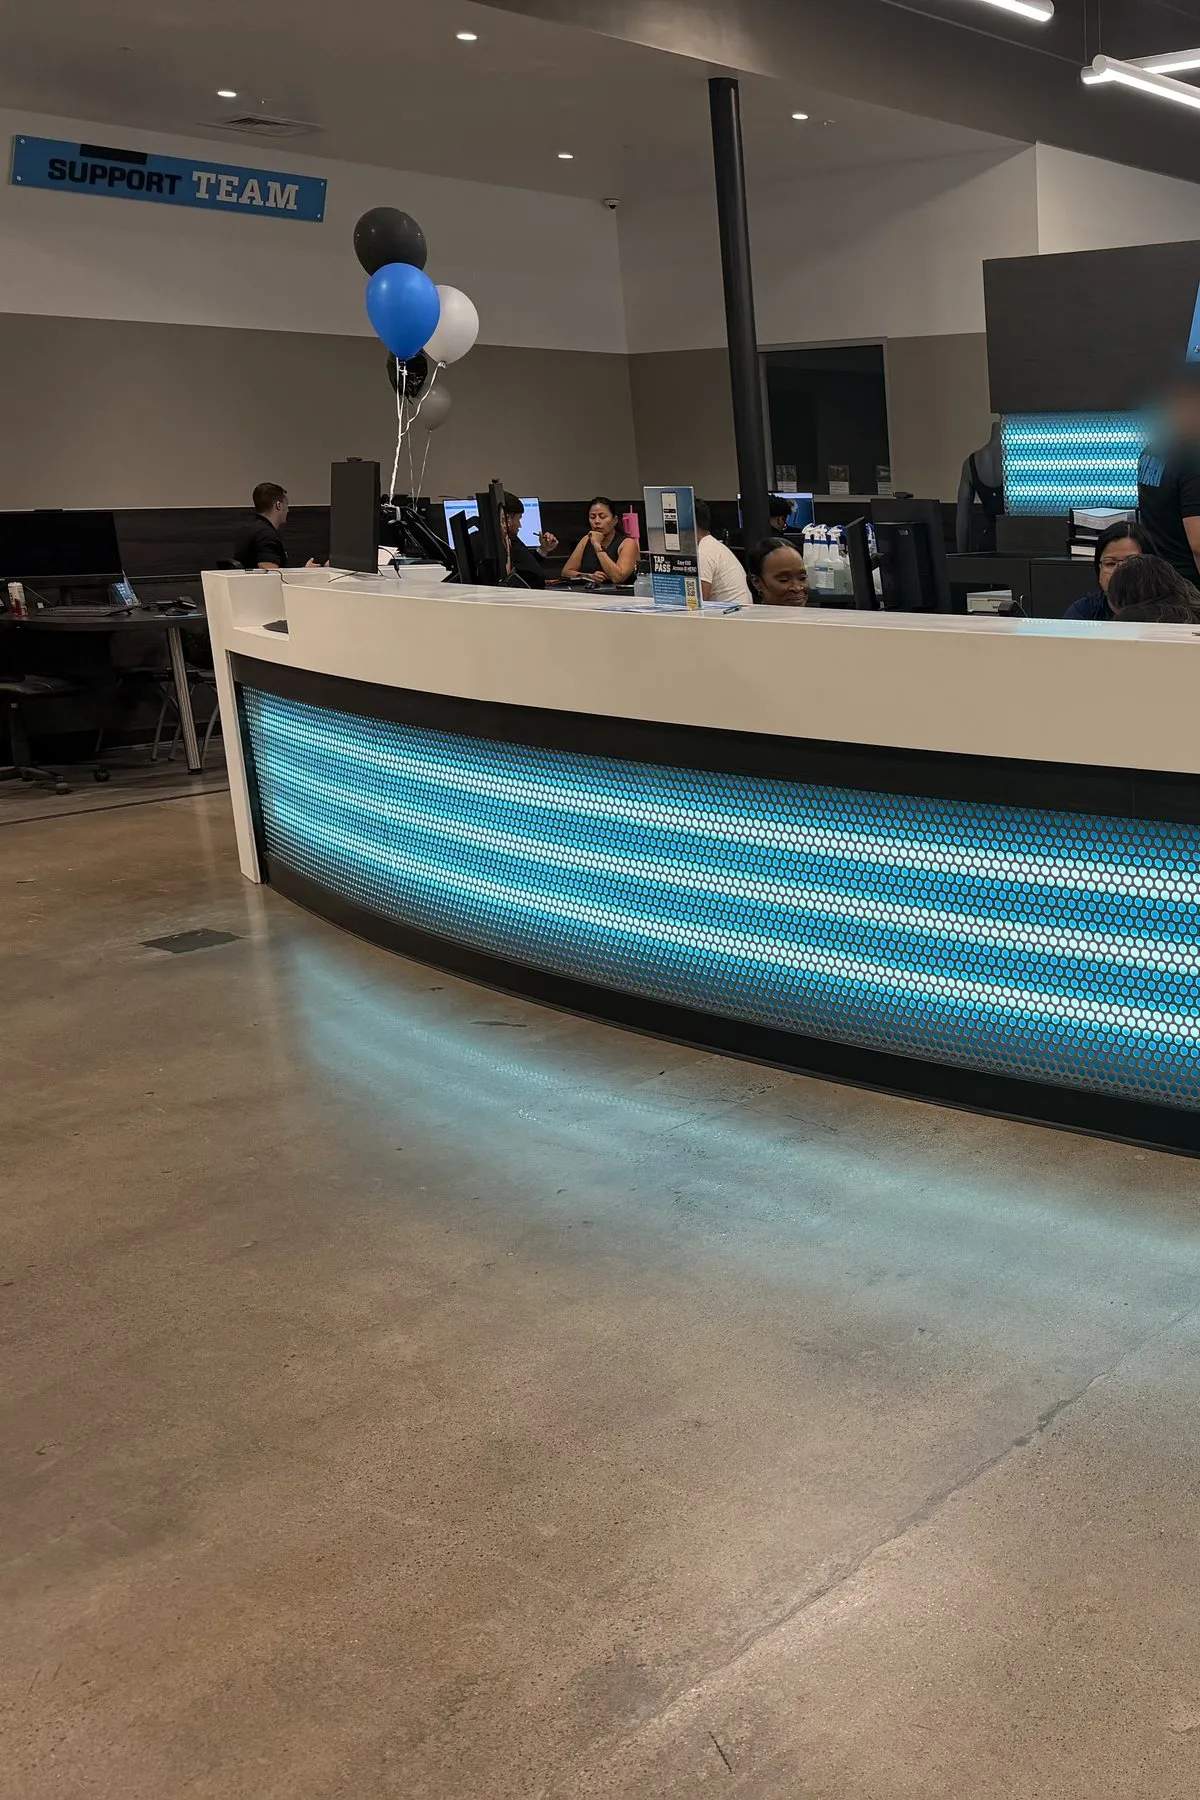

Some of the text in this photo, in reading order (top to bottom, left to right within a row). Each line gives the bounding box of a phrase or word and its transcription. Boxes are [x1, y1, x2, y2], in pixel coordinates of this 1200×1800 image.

[48, 158, 299, 210] SUPPORT TEAM
[653, 555, 665, 563] TAP
[654, 564, 671, 573] PASS
